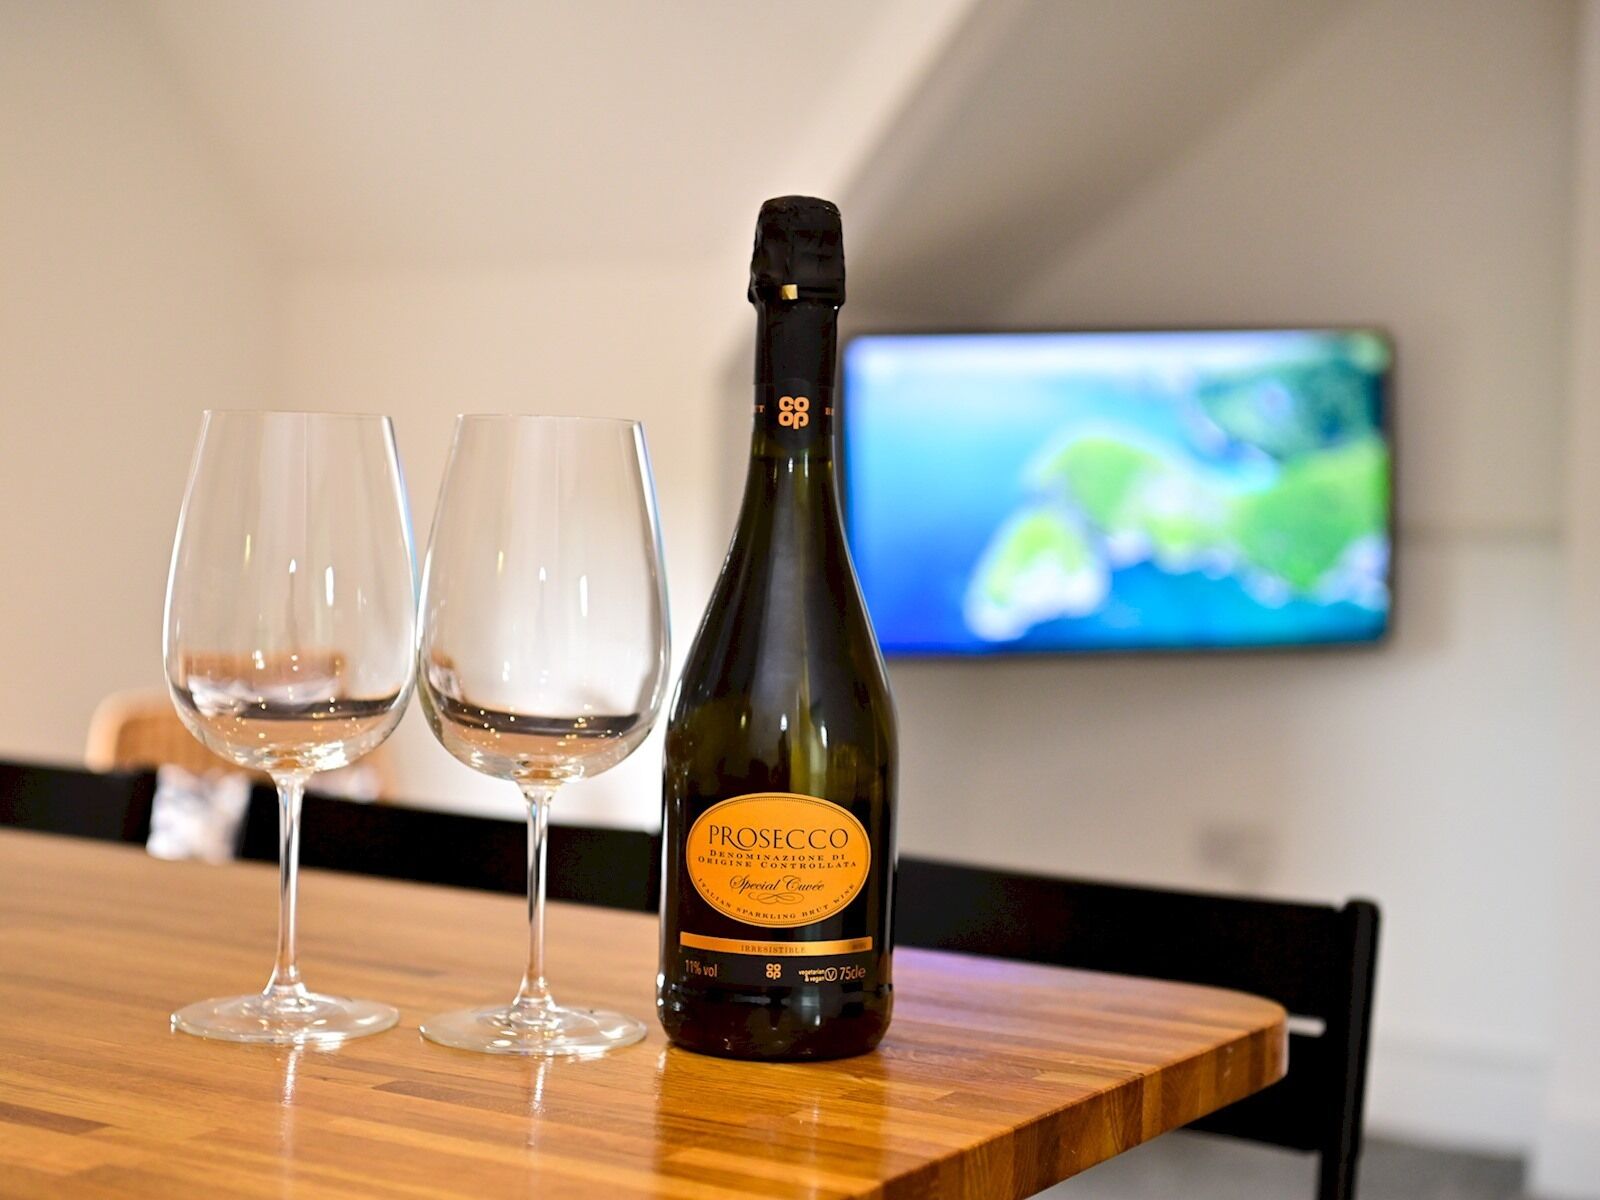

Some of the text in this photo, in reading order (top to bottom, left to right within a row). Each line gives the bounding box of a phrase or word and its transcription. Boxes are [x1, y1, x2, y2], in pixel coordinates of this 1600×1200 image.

[708, 824, 849, 851] PROSECCO
[730, 874, 825, 895] Special Cuvée
[698, 878, 855, 919] ITALIAN SPARKLING BRUT WINE
[740, 944, 806, 954] IRRESISTIBLE
[685, 959, 718, 977] 11% vol
